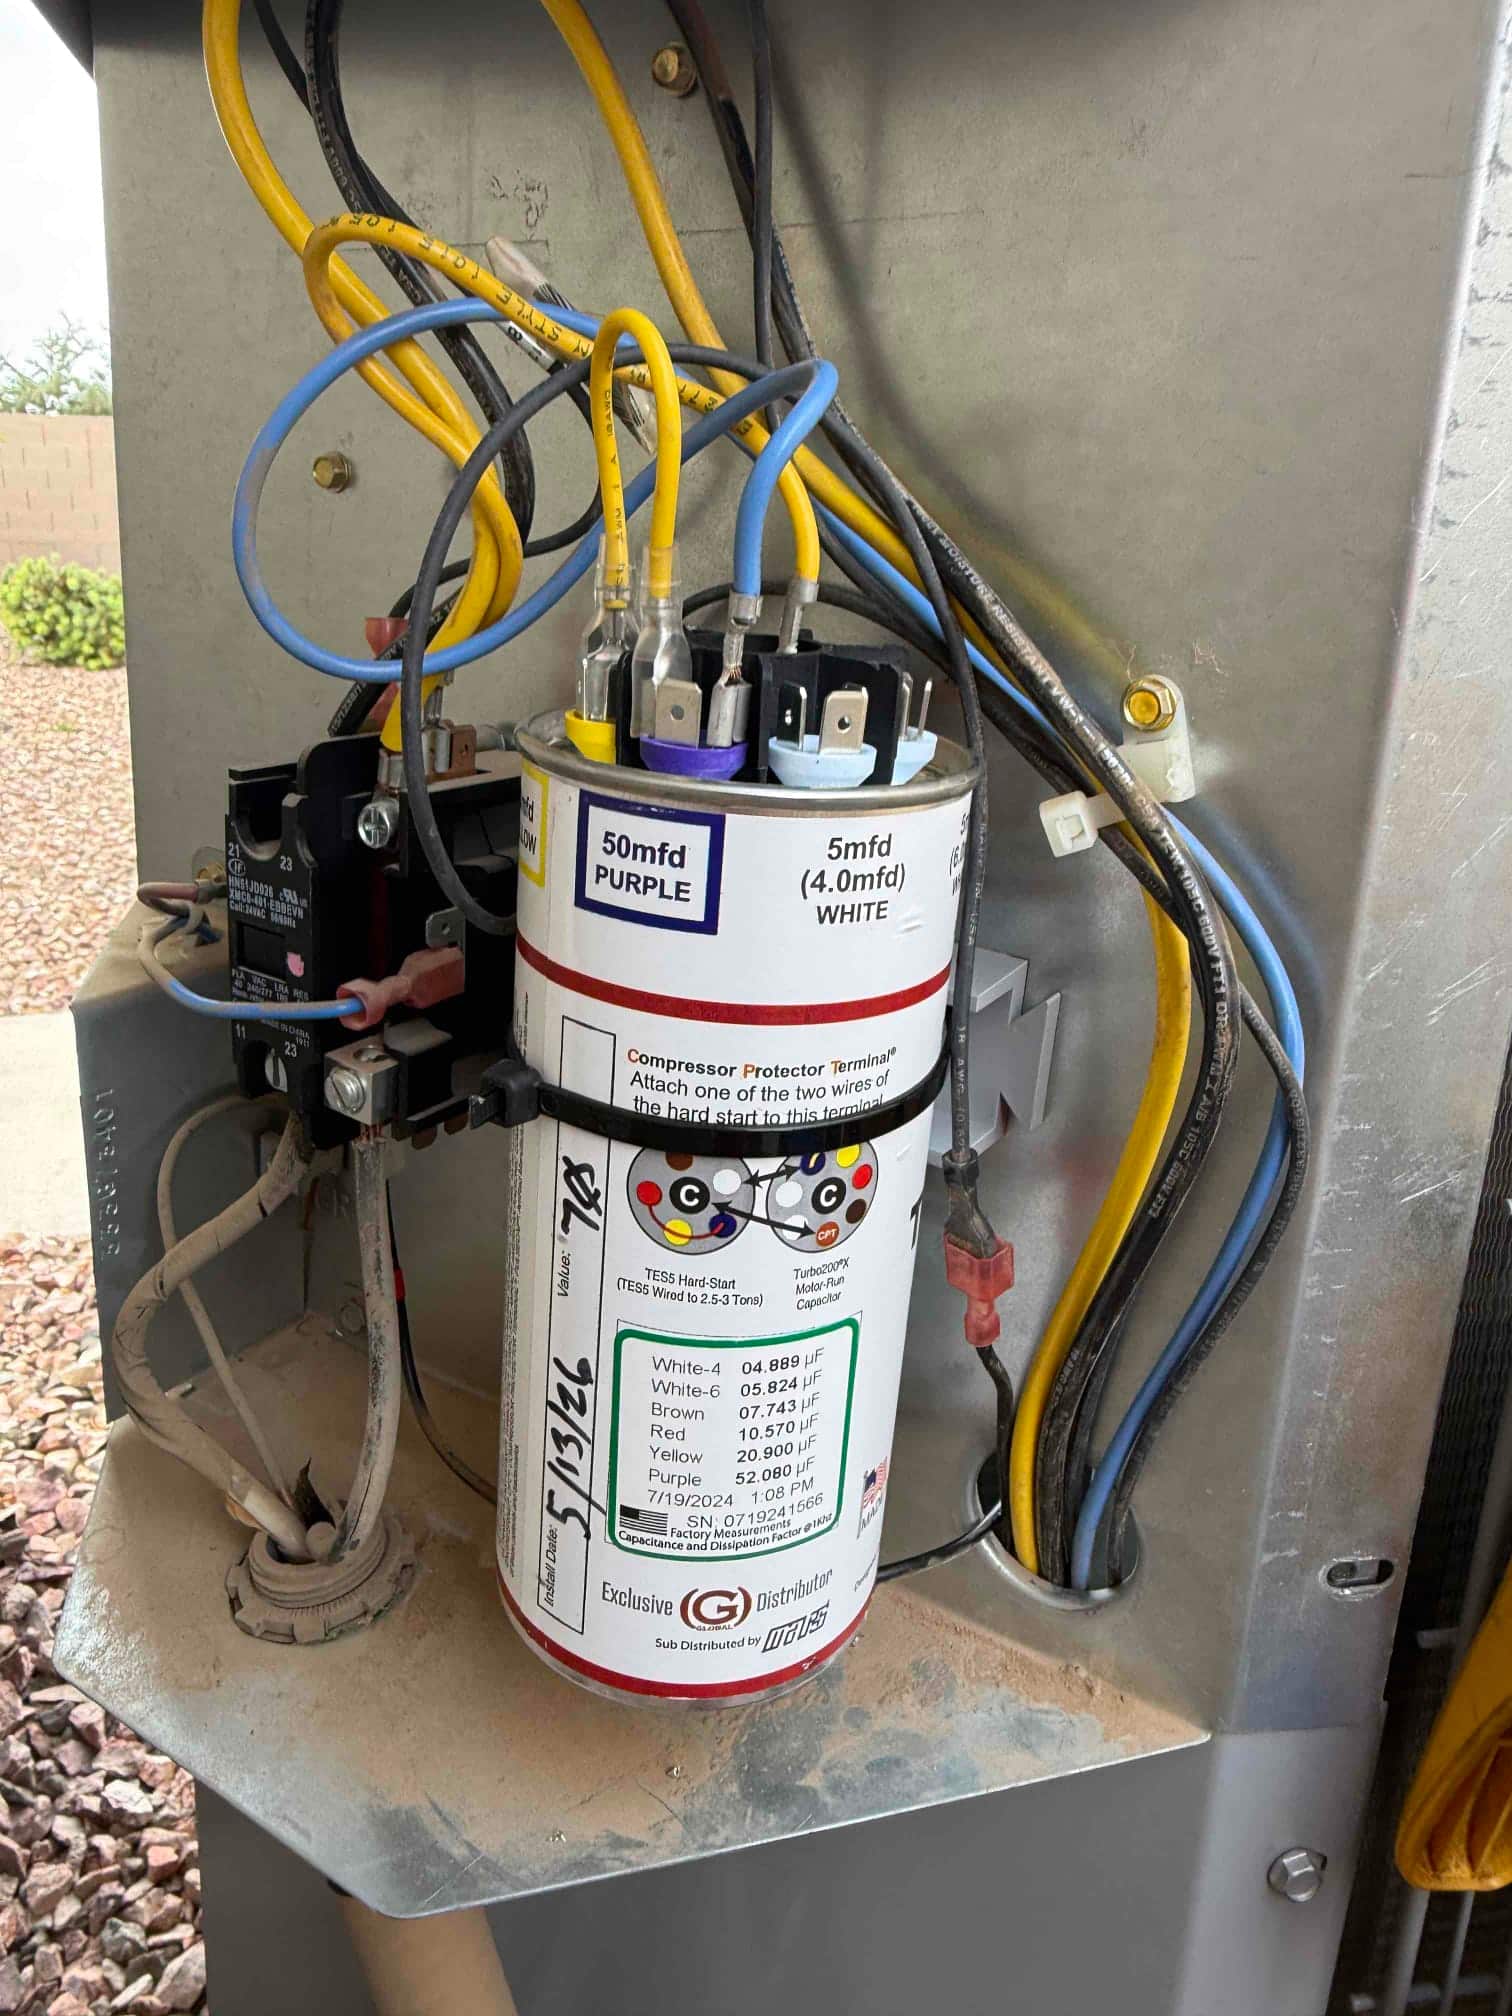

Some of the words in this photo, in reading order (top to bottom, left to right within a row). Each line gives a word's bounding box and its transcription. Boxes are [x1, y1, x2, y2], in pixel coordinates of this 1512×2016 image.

[228, 842, 240, 858] 21
[602, 831, 687, 869] 50mfd
[827, 833, 892, 861] 5mfd
[280, 856, 293, 872] 23
[594, 864, 692, 903] PURPLE
[800, 863, 906, 900] (4.0mfd)
[816, 900, 889, 925] WHITE
[285, 1041, 297, 1058] 23
[627, 1048, 737, 1078] Compressor
[743, 1062, 825, 1079] Protector
[630, 1070, 688, 1098] Attach
[695, 1085, 731, 1101] one
[737, 1085, 756, 1102] of
[760, 1085, 789, 1101] the
[796, 1084, 826, 1099] two
[832, 1077, 871, 1098] wires
[876, 1069, 890, 1088] of
[634, 1094, 661, 1116] the
[668, 1098, 709, 1122] hard
[716, 1109, 757, 1126] start
[764, 1109, 781, 1126] to
[787, 1107, 818, 1125] this
[817, 1229, 836, 1241] CPT
[557, 1250, 572, 1297] Value:
[645, 1266, 675, 1284] TES5
[678, 1273, 736, 1290] Hard-Start
[795, 1276, 845, 1295] Motor-Run
[617, 1277, 649, 1295] (TES5
[652, 1285, 684, 1302] Wired
[687, 1292, 698, 1304] to
[701, 1292, 730, 1306] 2.5-3
[732, 1293, 763, 1308] Tons)
[796, 1292, 842, 1311] Capacitor
[652, 1355, 721, 1376] White-4
[742, 1354, 800, 1375] 04.889
[652, 1377, 721, 1398] White-6
[741, 1376, 797, 1397] 05.824
[652, 1402, 705, 1420] Brown
[739, 1400, 797, 1420] 07.743
[651, 1424, 686, 1441] Red
[739, 1421, 795, 1442] 10.570
[546, 1356, 607, 1540] 5/13/26
[650, 1446, 703, 1465] Yellow
[737, 1443, 793, 1463] 20.900
[649, 1468, 701, 1489] Purple
[735, 1464, 792, 1485] 52.080
[648, 1489, 734, 1509] 7/19/2024
[751, 1486, 785, 1505] 1:08
[791, 1476, 814, 1497] PM
[671, 1526, 711, 1542] Factory
[714, 1519, 791, 1538] Measurements
[687, 1514, 720, 1530] SN:
[618, 1530, 684, 1551] Capacitance
[686, 1541, 708, 1551] and
[710, 1537, 769, 1552] Dissipation
[772, 1527, 802, 1544] Factor
[602, 1581, 673, 1617] Exclusive
[756, 1568, 833, 1613] Distributor
[655, 1638, 678, 1650] Sub
[680, 1638, 745, 1651] Distributed
[748, 1635, 761, 1648] by
